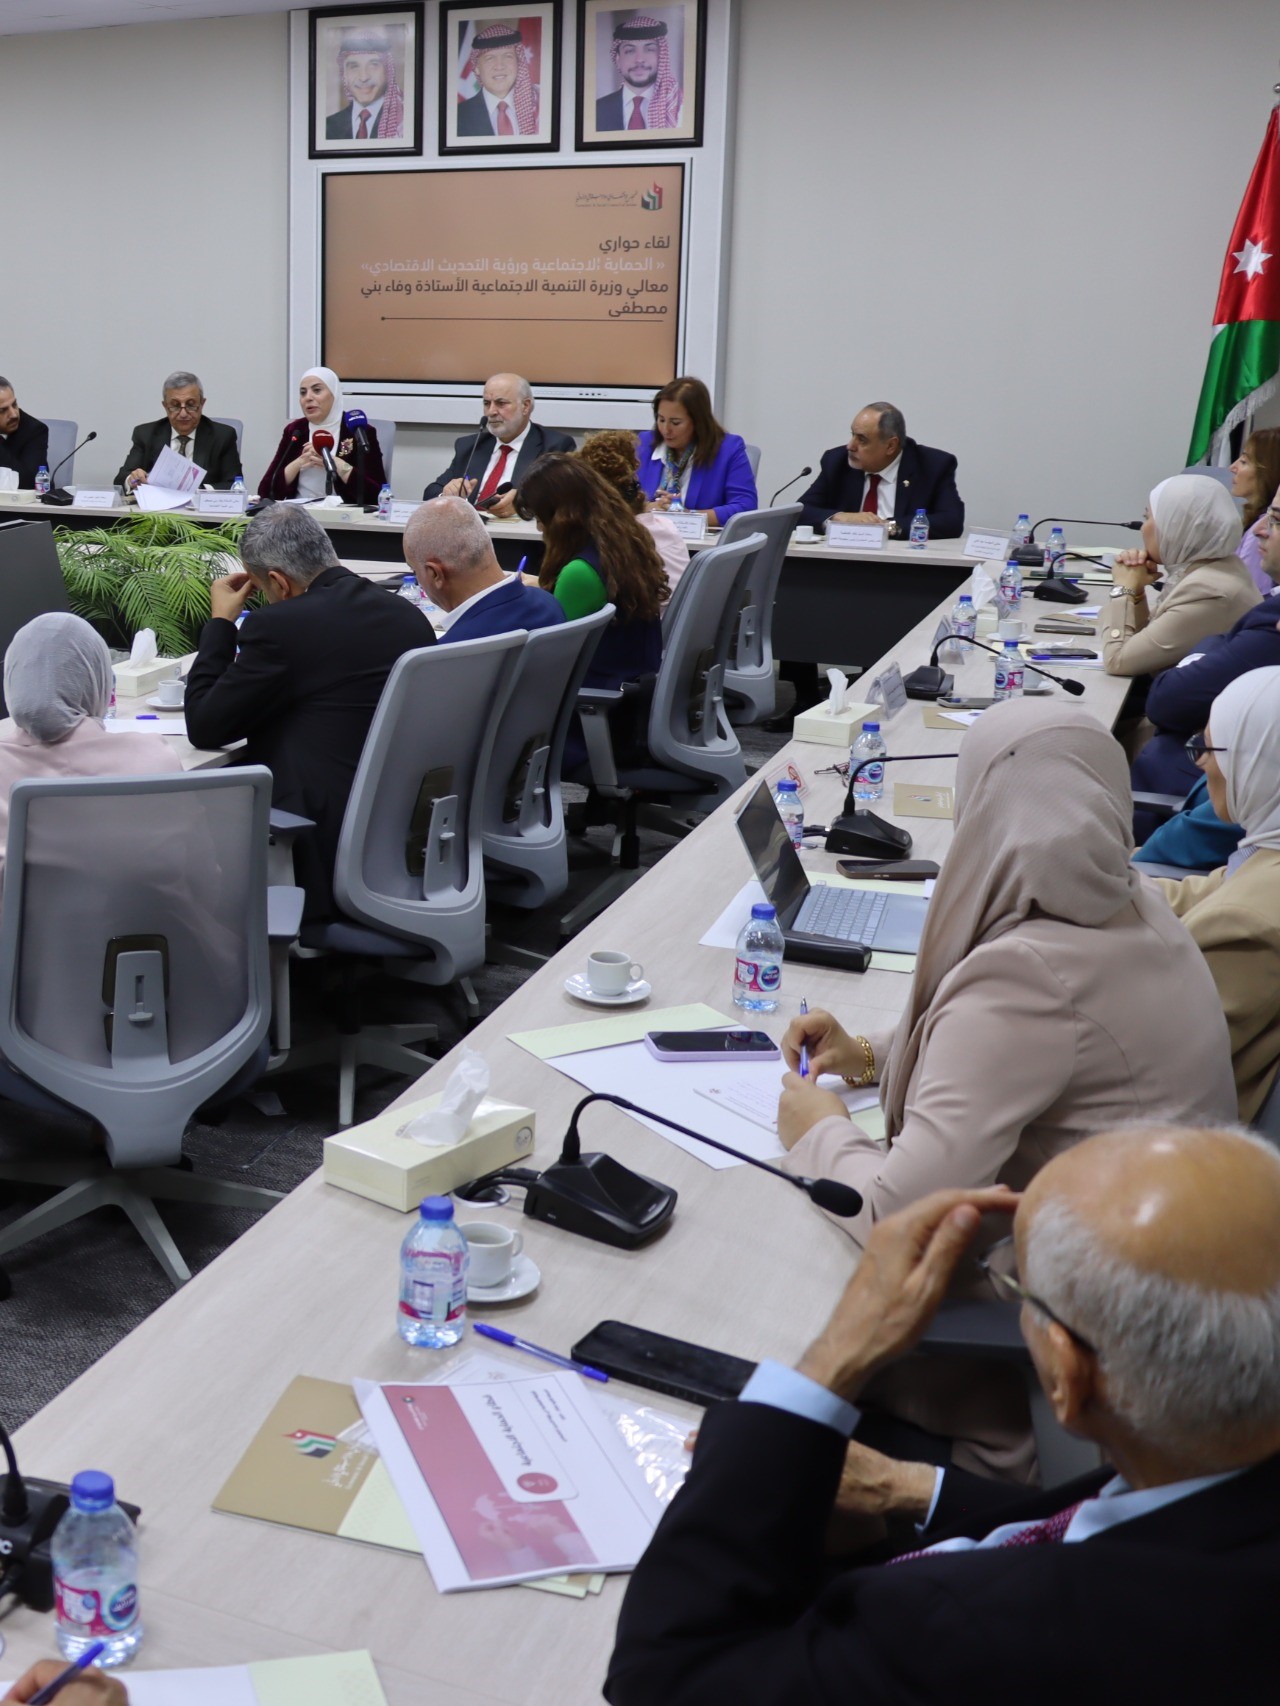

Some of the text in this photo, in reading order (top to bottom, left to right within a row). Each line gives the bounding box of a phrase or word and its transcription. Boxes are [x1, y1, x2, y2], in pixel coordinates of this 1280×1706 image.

[599, 235, 670, 254] لقاء حواري
[437, 257, 489, 275] التحديث
[493, 256, 529, 275] ورؤية
[604, 256, 653, 274] الحماية
[360, 277, 669, 299] معالي وزيرة التنمية الاجتماعية الأستاذة وفاء بني
[608, 301, 668, 318] مصطفى
